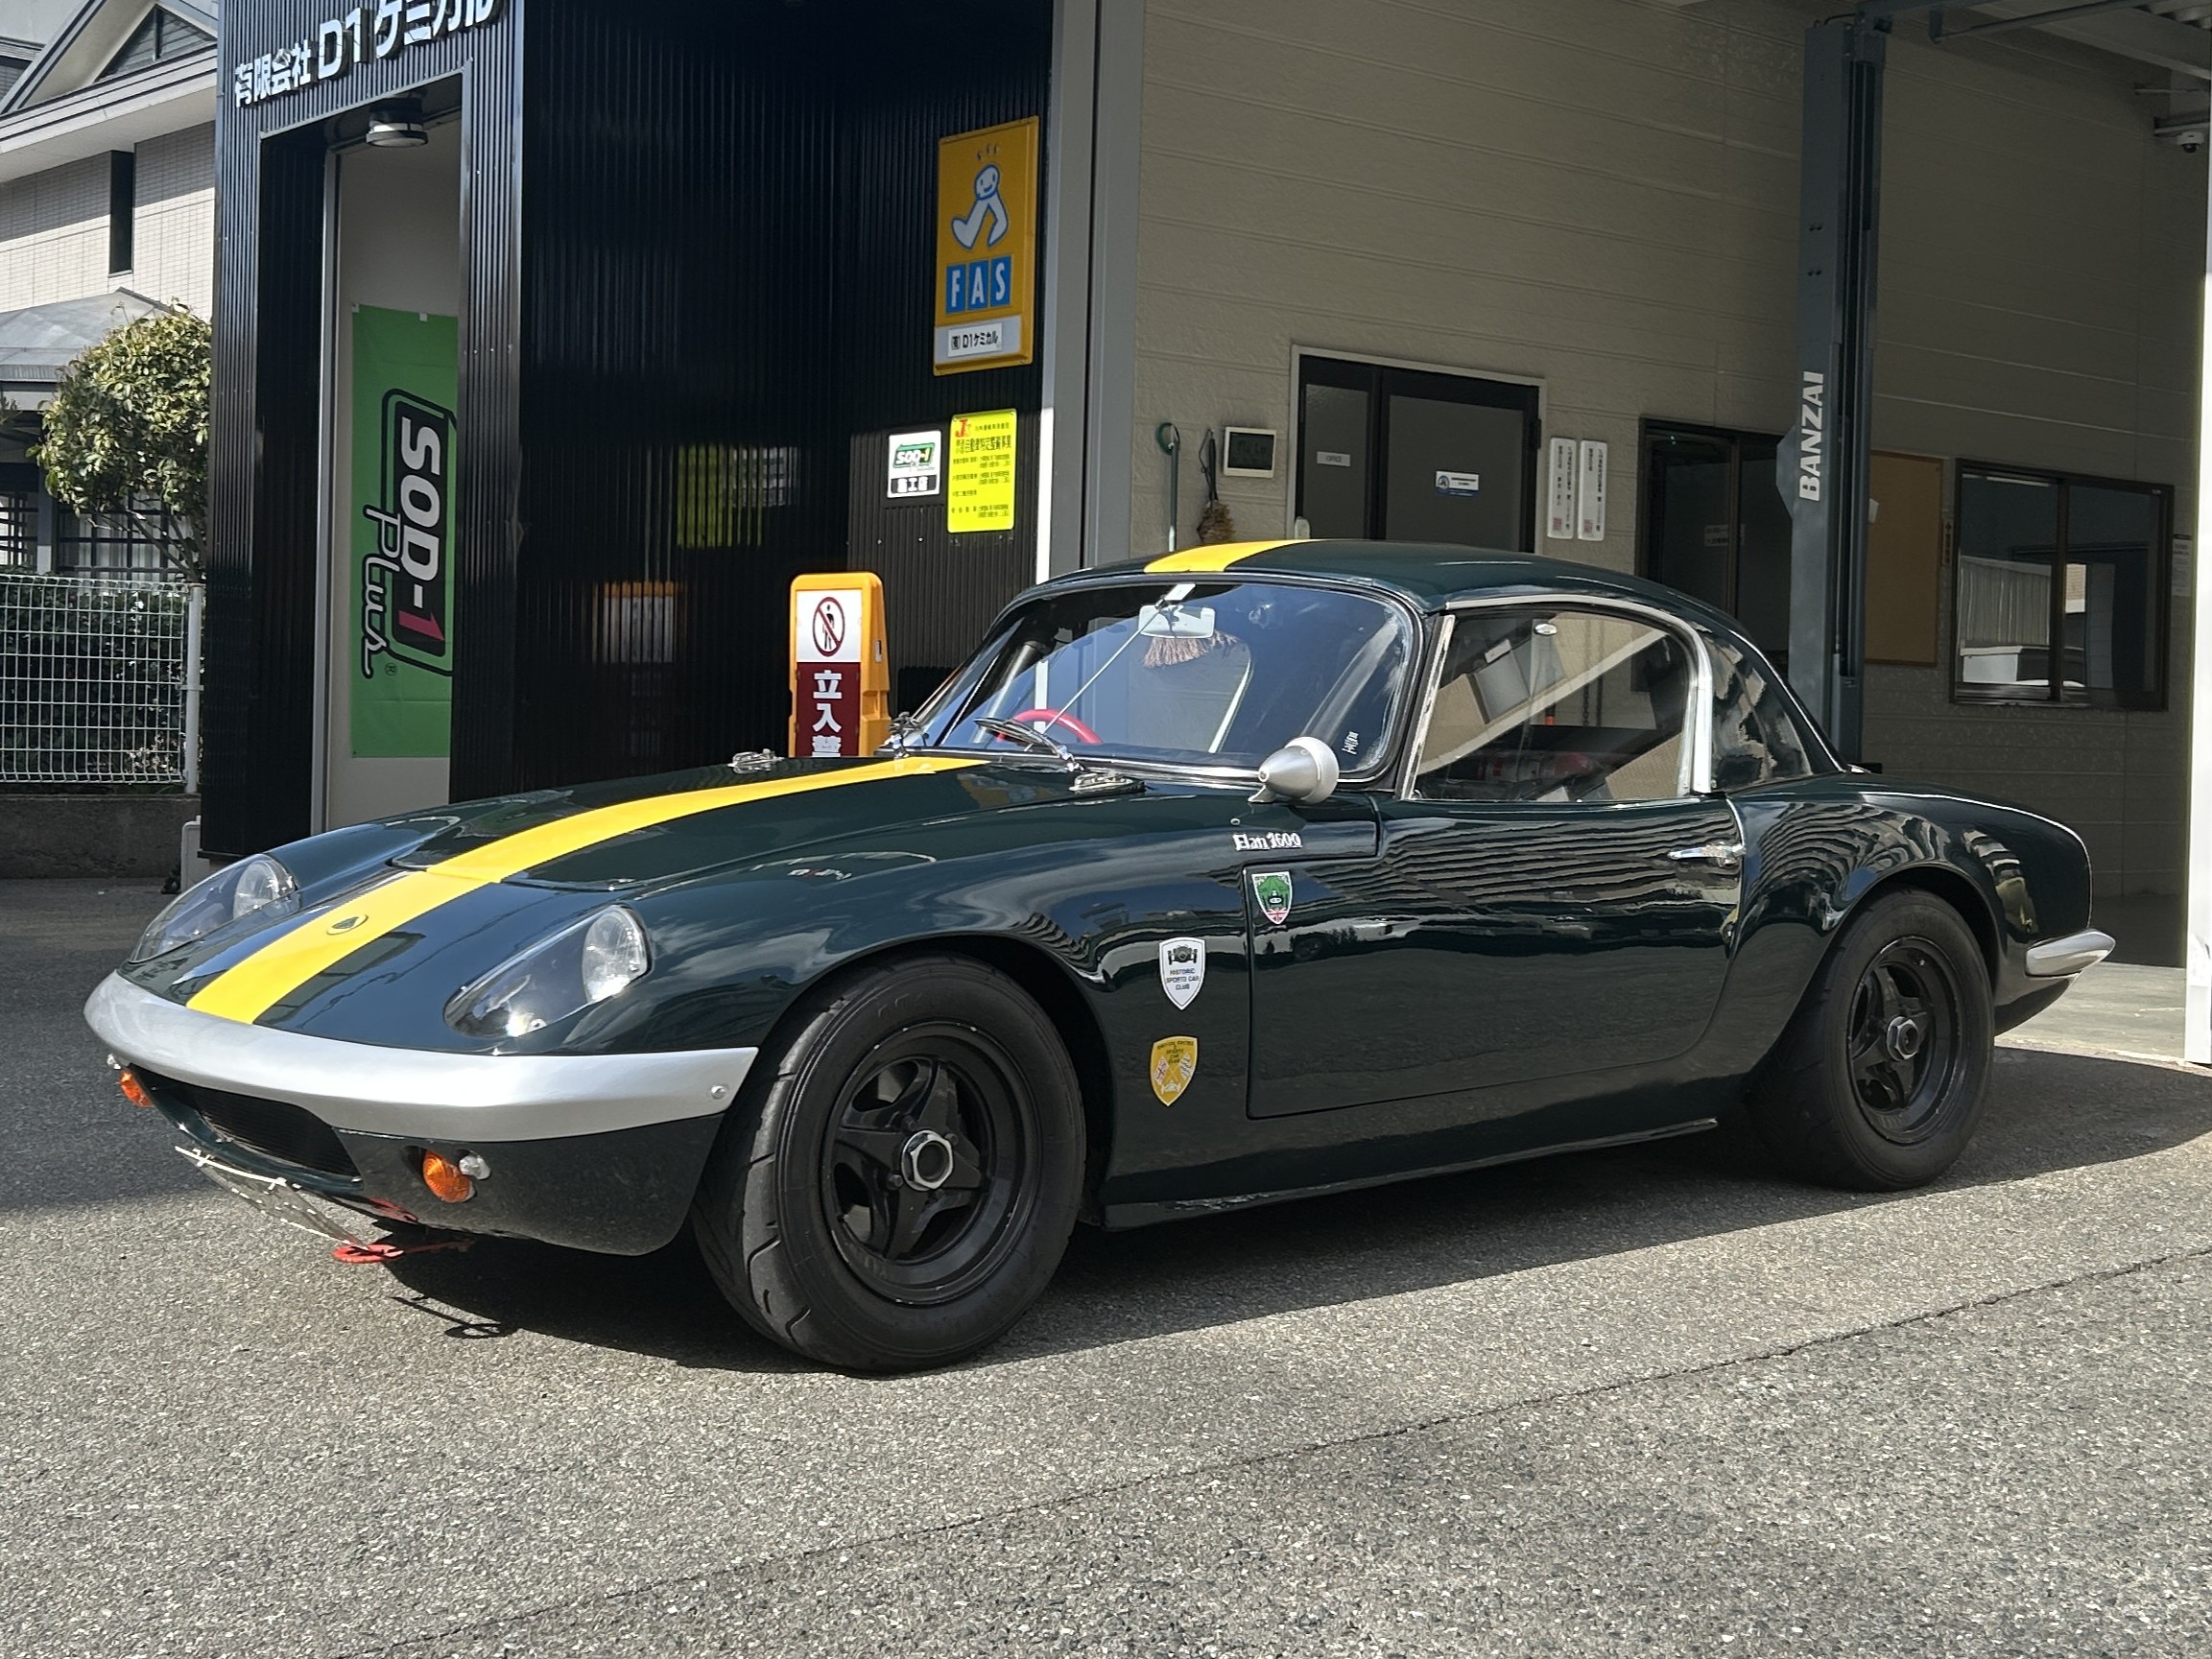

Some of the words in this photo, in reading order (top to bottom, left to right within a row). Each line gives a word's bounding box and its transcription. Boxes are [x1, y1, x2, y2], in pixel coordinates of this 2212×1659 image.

[234, 39, 311, 108] 有限会社
[1799, 371, 1823, 501] BANZAI
[400, 416, 445, 642] SOD-1
[1232, 833, 1270, 851] Elan
